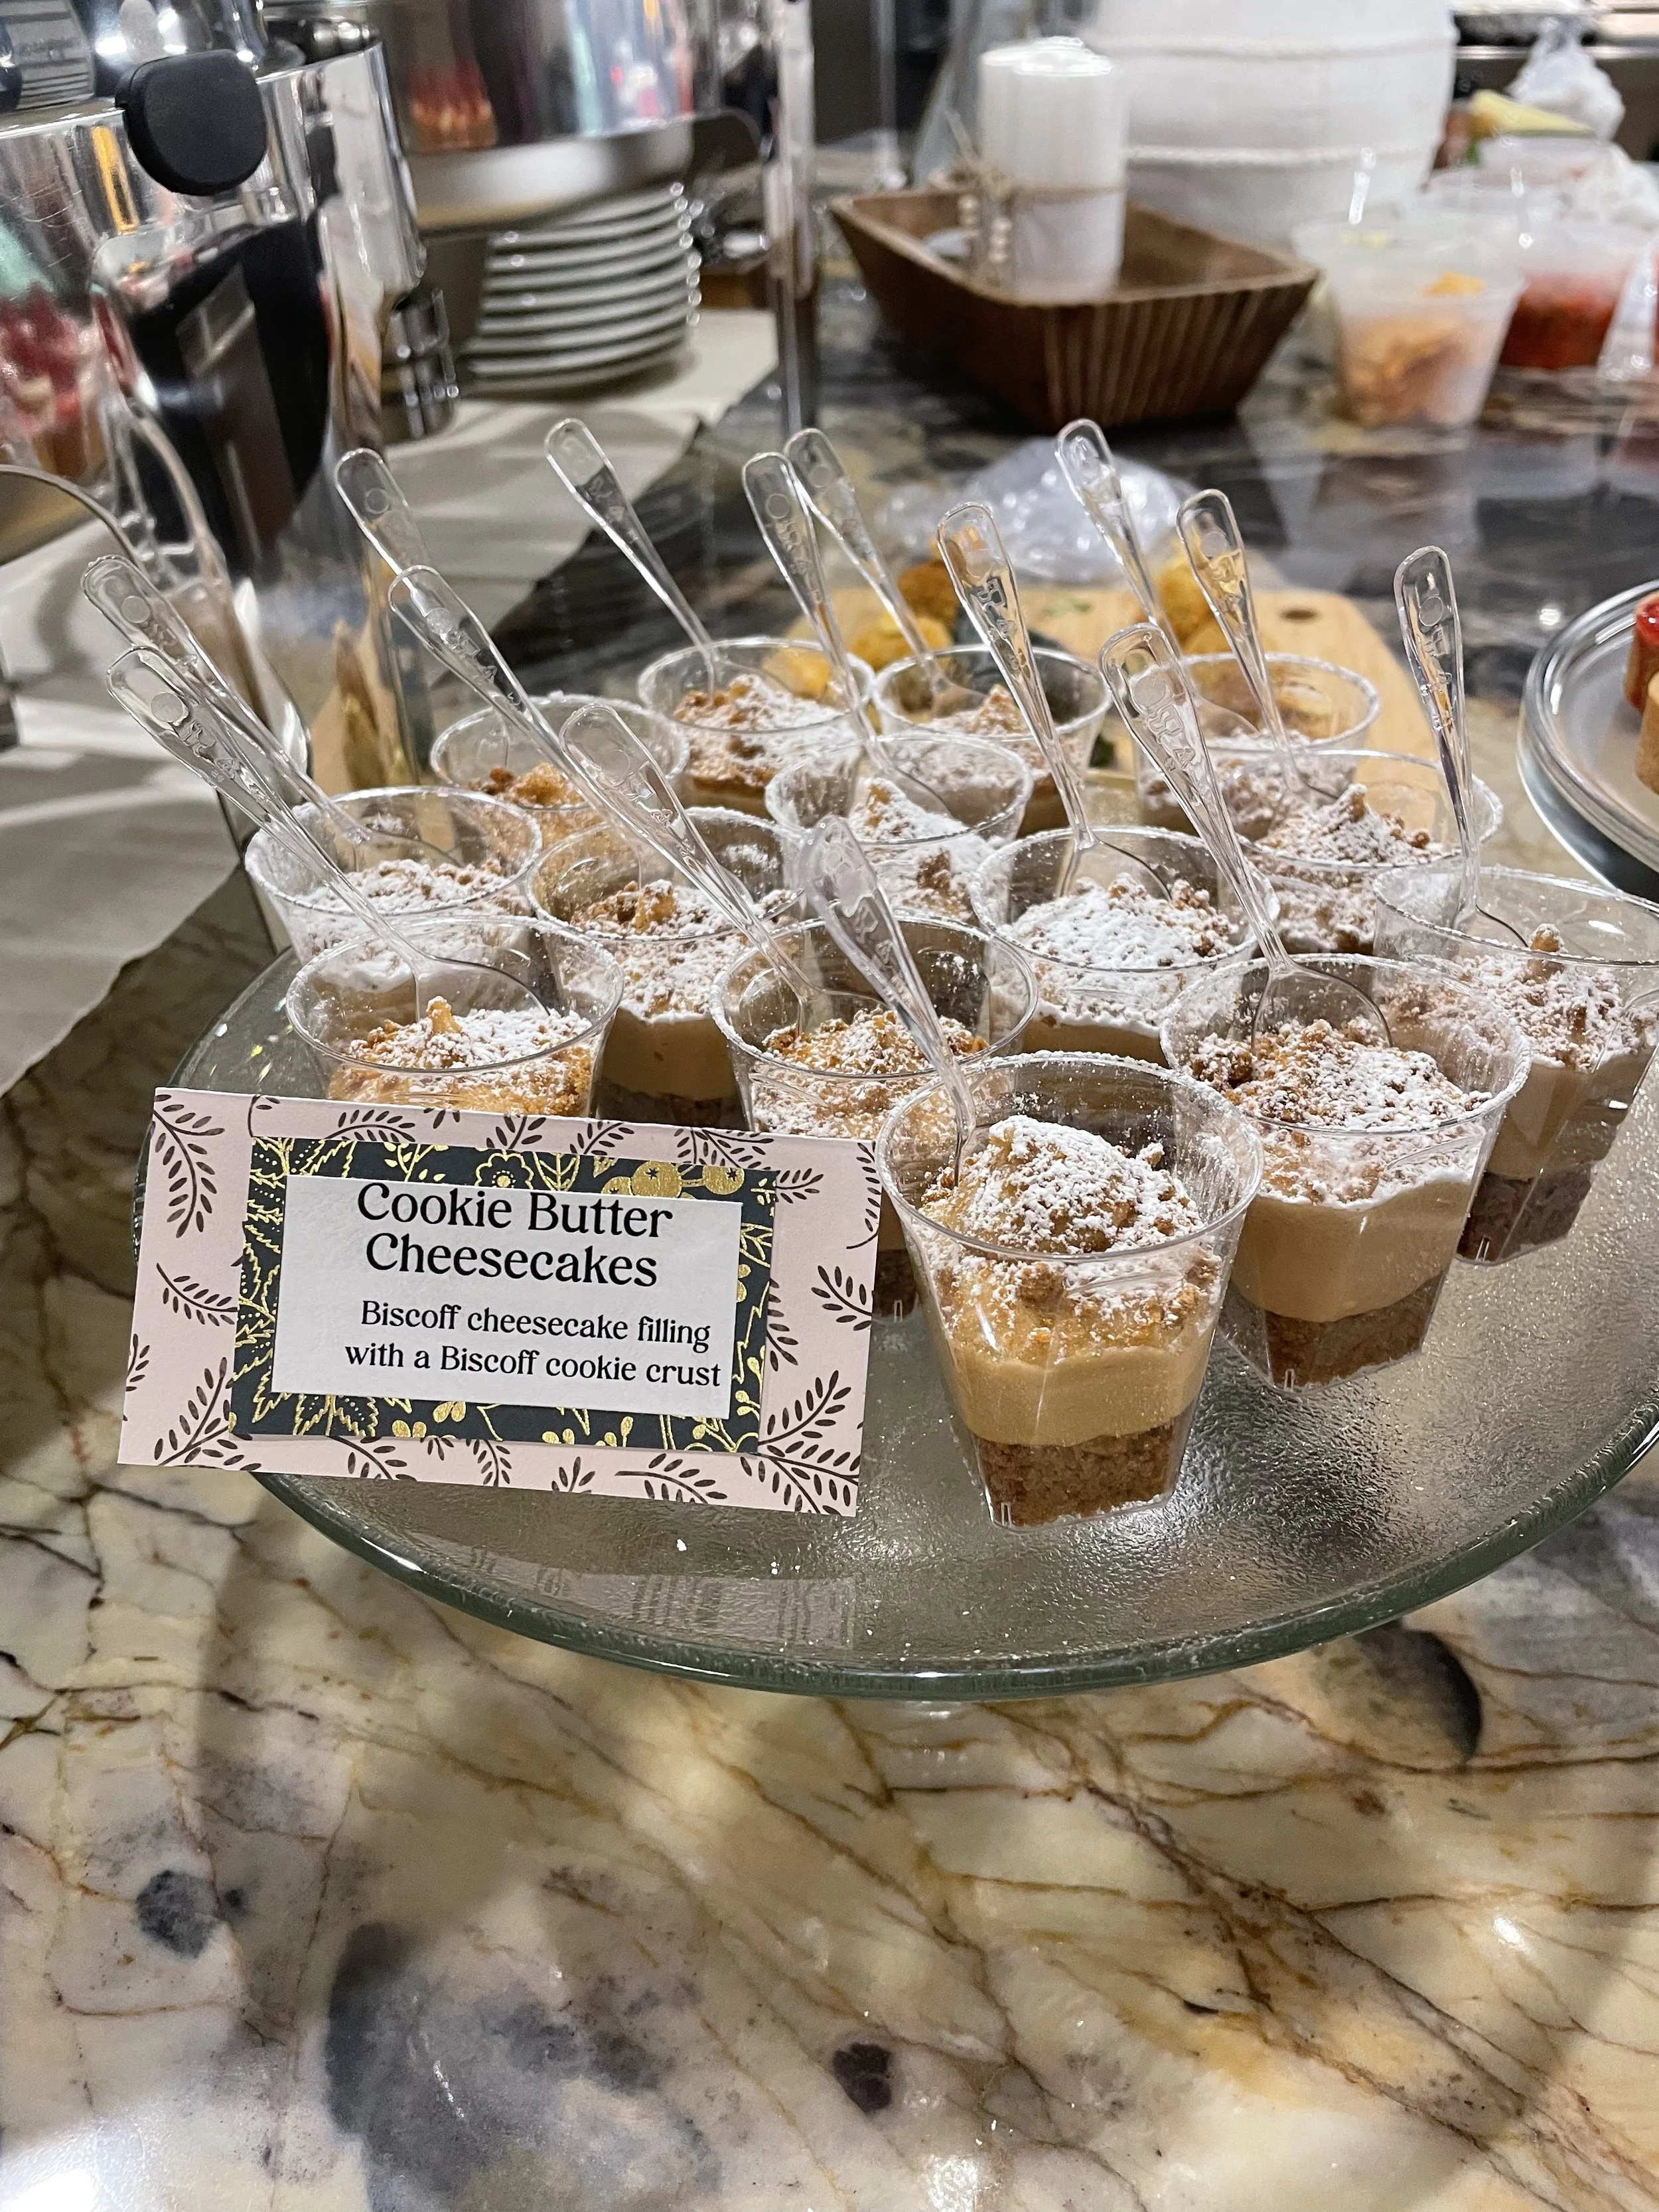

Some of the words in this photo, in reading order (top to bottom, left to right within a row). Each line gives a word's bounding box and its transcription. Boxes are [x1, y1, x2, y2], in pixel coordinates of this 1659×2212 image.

[358, 1183, 512, 1228] Cookie
[528, 1192, 673, 1238] Butter
[367, 1233, 656, 1287] Cheesecakes
[362, 1301, 461, 1330] Biscoff
[468, 1307, 628, 1340] cheesecake
[638, 1316, 710, 1353] filling
[345, 1343, 403, 1368] with
[414, 1351, 430, 1368] a
[440, 1346, 540, 1375] Biscoff
[546, 1355, 636, 1381] cookie
[646, 1364, 721, 1386] crust
